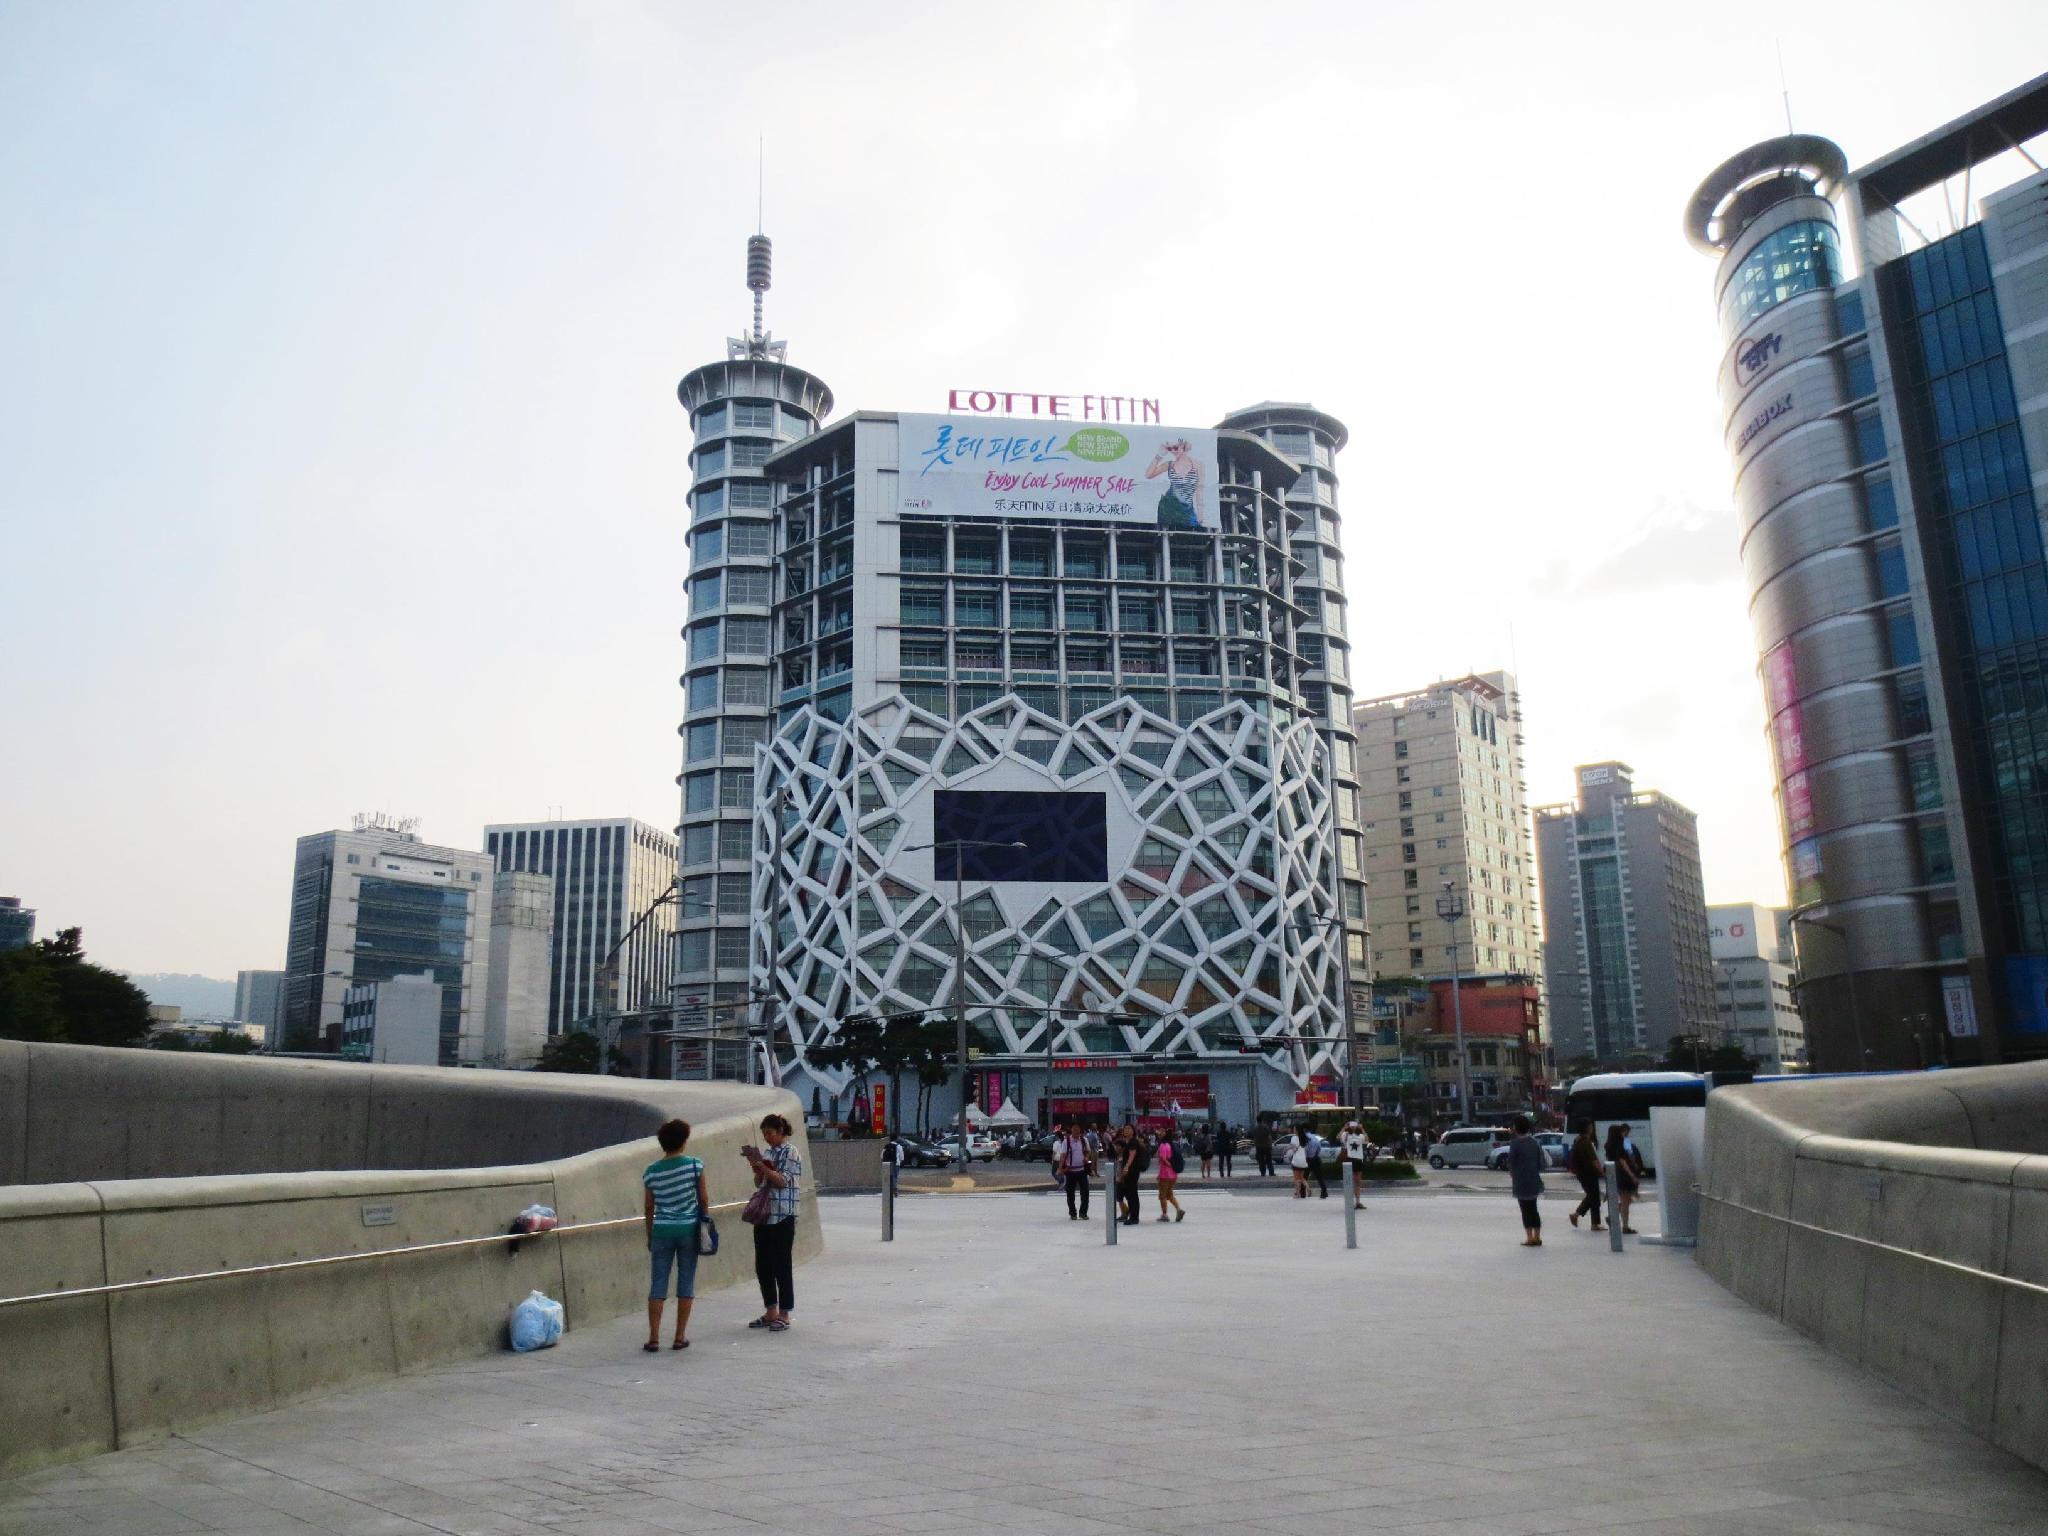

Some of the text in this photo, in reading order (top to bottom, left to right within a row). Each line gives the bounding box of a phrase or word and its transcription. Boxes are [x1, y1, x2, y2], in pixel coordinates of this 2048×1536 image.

[949, 389, 1161, 423] LOTTE FITIN
[1085, 1085, 1103, 1096] Hall
